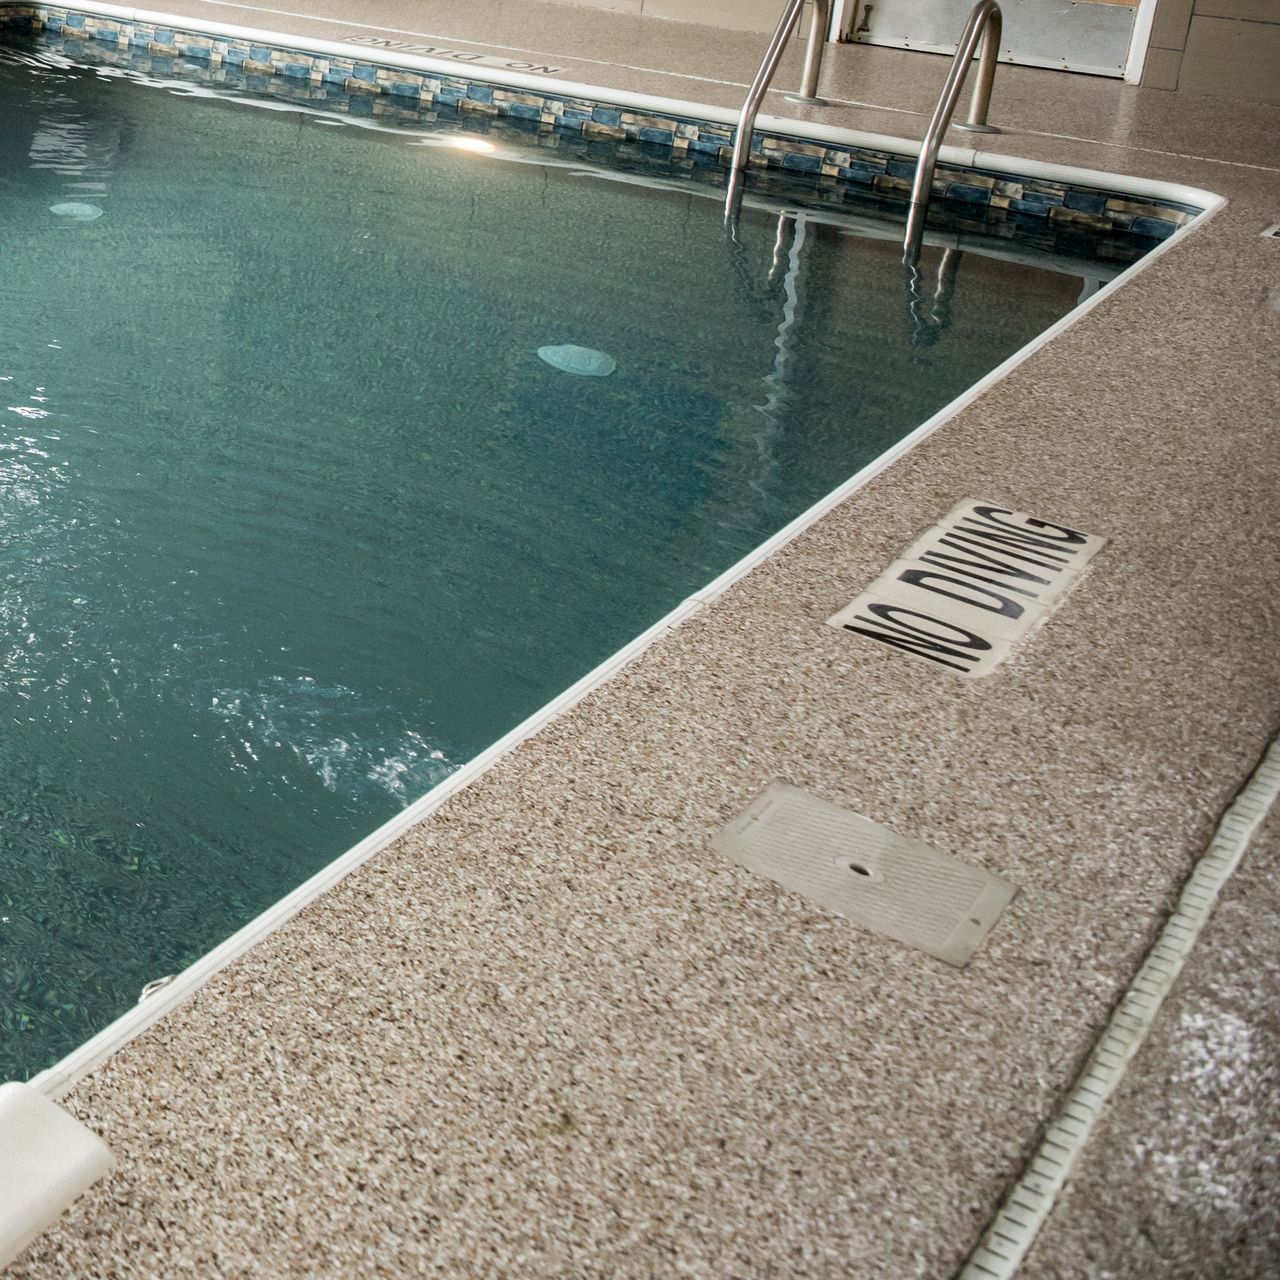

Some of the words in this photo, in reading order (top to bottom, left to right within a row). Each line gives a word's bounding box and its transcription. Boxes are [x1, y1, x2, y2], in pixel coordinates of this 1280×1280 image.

[351, 35, 486, 61] DIVING
[506, 62, 560, 74] NO
[896, 505, 1089, 620] DIVING
[842, 603, 992, 672] NO
